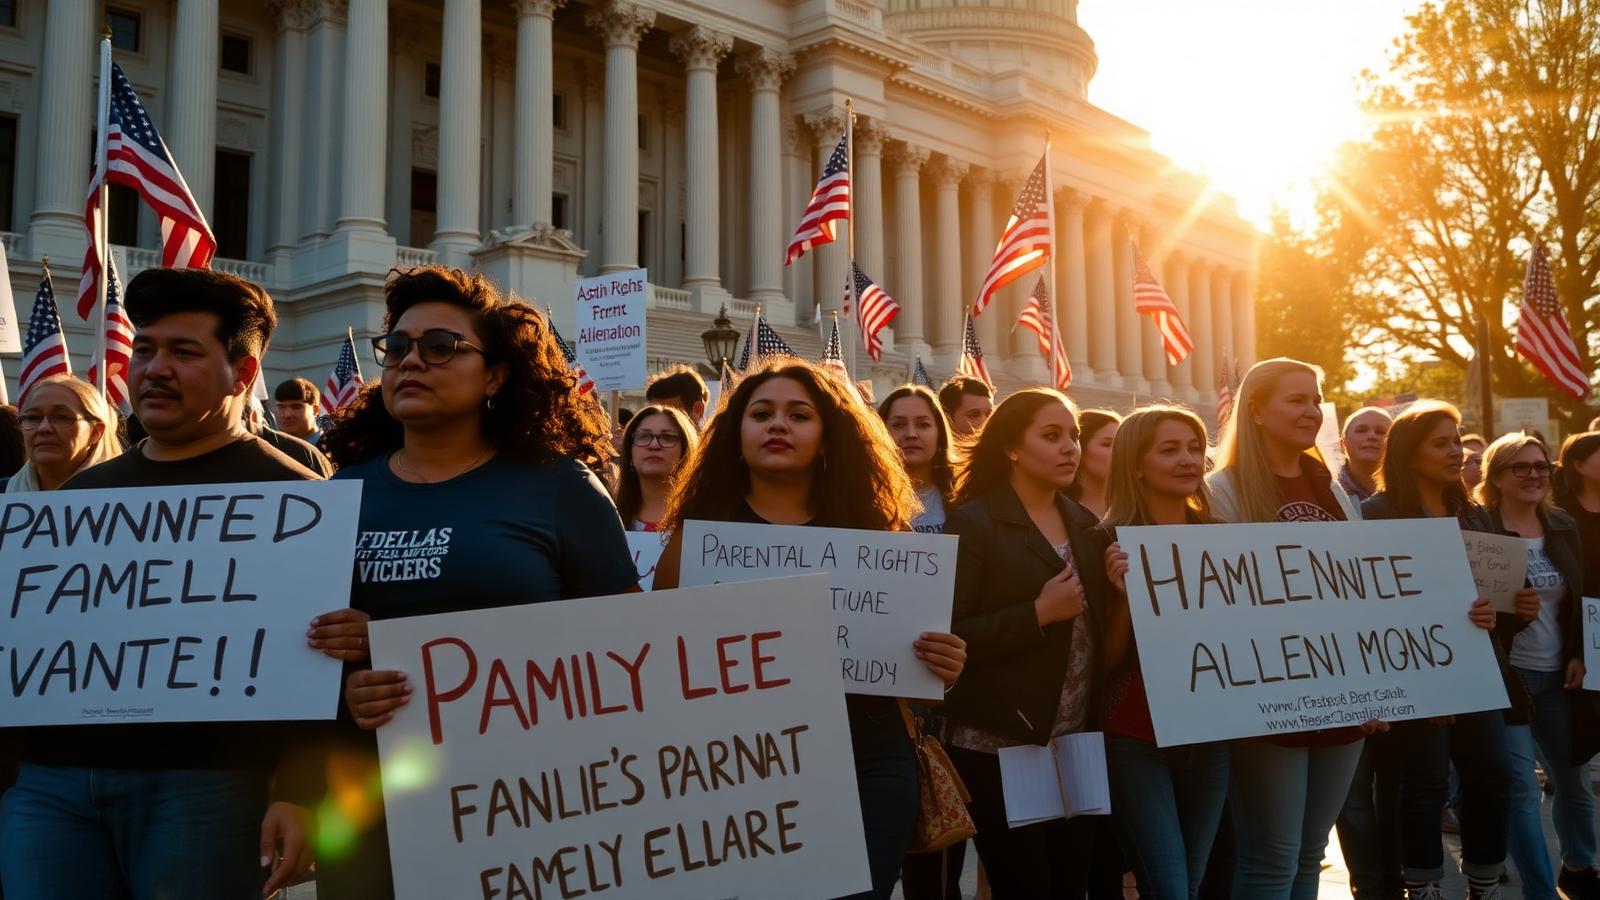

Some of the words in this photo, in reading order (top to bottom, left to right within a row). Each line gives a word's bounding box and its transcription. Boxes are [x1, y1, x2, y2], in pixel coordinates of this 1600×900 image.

[10, 558, 258, 619] FAMELL
[702, 533, 812, 569] PARENTAL
[857, 545, 939, 576] RIGHTS
[0, 628, 266, 697] VANTE!!
[421, 637, 651, 745] PAMILY
[677, 631, 791, 700] LEE
[840, 657, 897, 685] RLIDY
[658, 724, 809, 799] PARNAT
[480, 834, 623, 900] FAMELY
[643, 800, 803, 879] ELLARE
